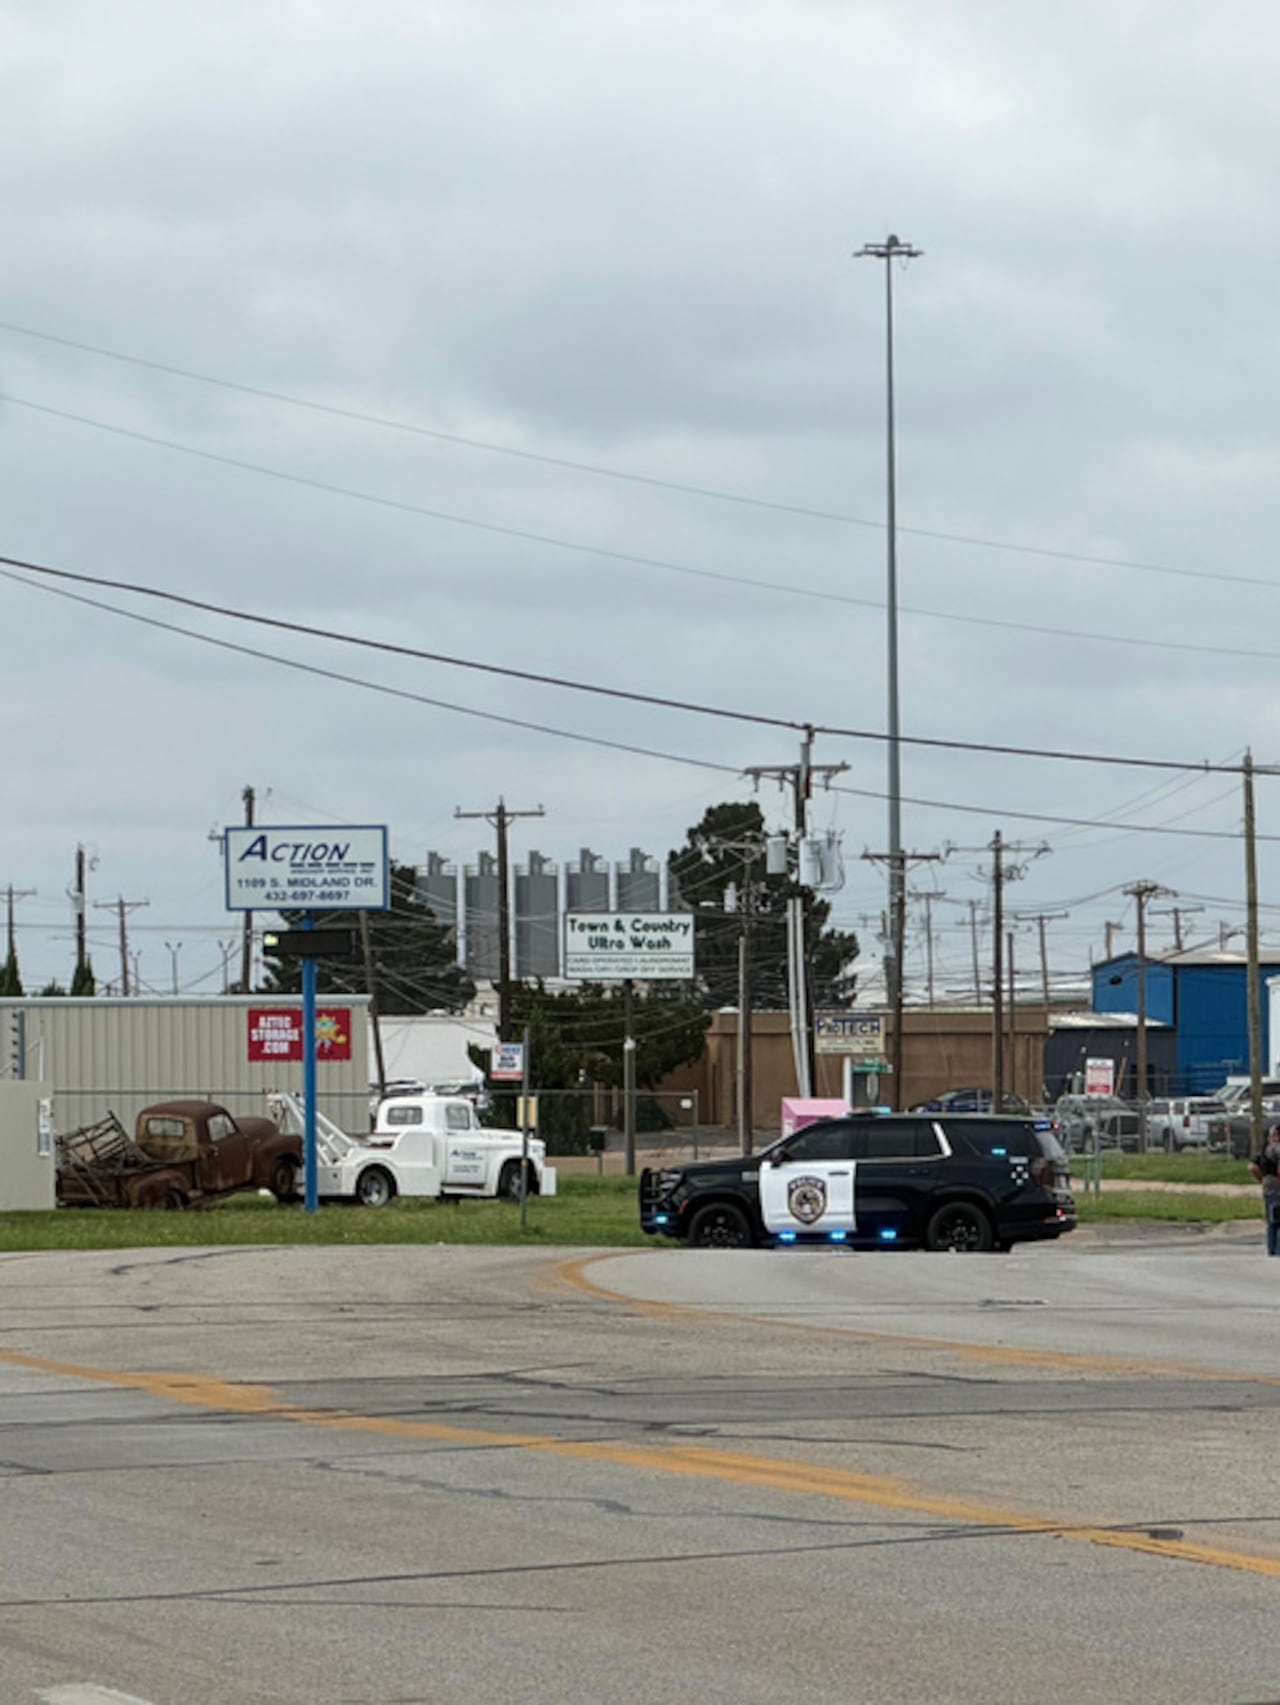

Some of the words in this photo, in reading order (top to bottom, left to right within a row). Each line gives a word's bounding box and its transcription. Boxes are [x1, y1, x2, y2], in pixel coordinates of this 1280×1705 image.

[287, 877, 350, 887] MIDLAND
[569, 918, 609, 932] Town
[614, 918, 625, 933] &
[631, 918, 690, 936] Country
[588, 936, 625, 949] Ultra
[630, 936, 671, 949] Wash
